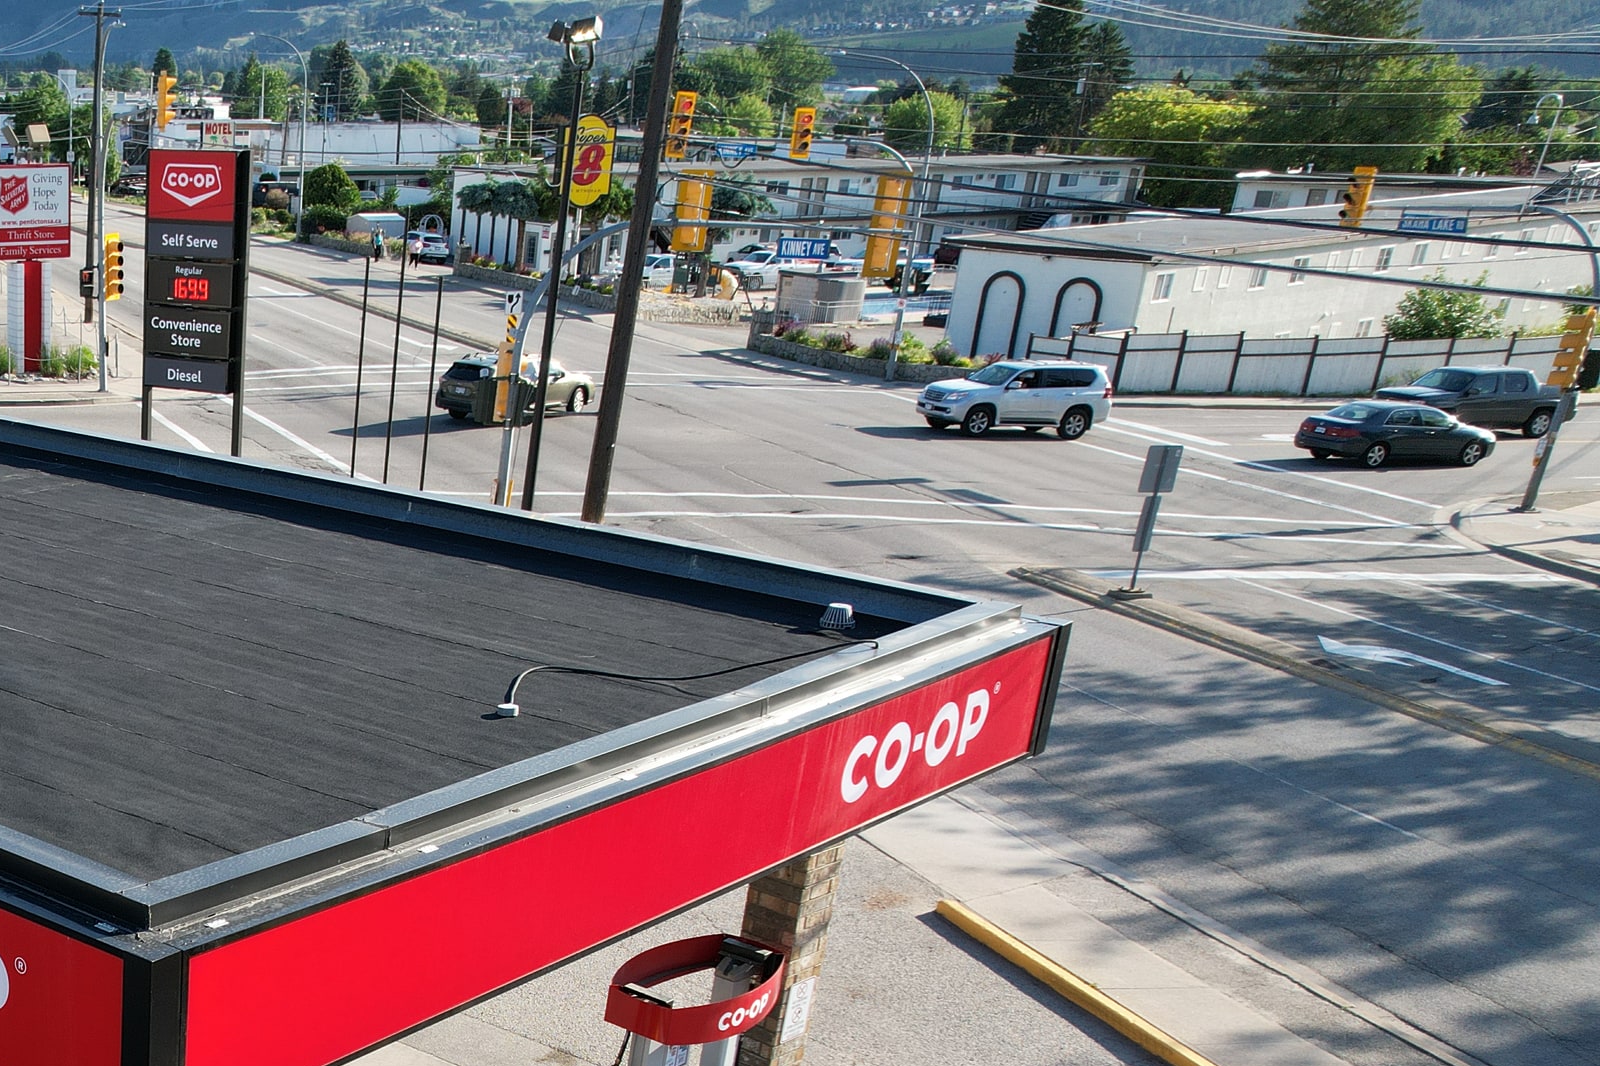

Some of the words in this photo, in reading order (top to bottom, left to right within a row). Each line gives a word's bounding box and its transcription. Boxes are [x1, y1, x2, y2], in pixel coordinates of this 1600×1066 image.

[205, 123, 232, 134] MOTEL
[572, 144, 606, 186] 8
[32, 173, 62, 185] Giving
[33, 188, 56, 199] Hope
[33, 201, 59, 213] Today
[1432, 219, 1455, 231] LAKE
[8, 230, 32, 240] Thrift
[34, 230, 55, 238] Store
[162, 234, 184, 247] Self
[186, 235, 218, 249] Serve
[0, 247, 28, 257] Family
[29, 246, 62, 255] Services
[781, 240, 812, 256] KINNEY
[812, 243, 826, 255] AVE
[175, 266, 203, 276] Regular
[151, 317, 222, 334] Convenience
[170, 334, 201, 347] Store
[167, 368, 202, 383] Diesel
